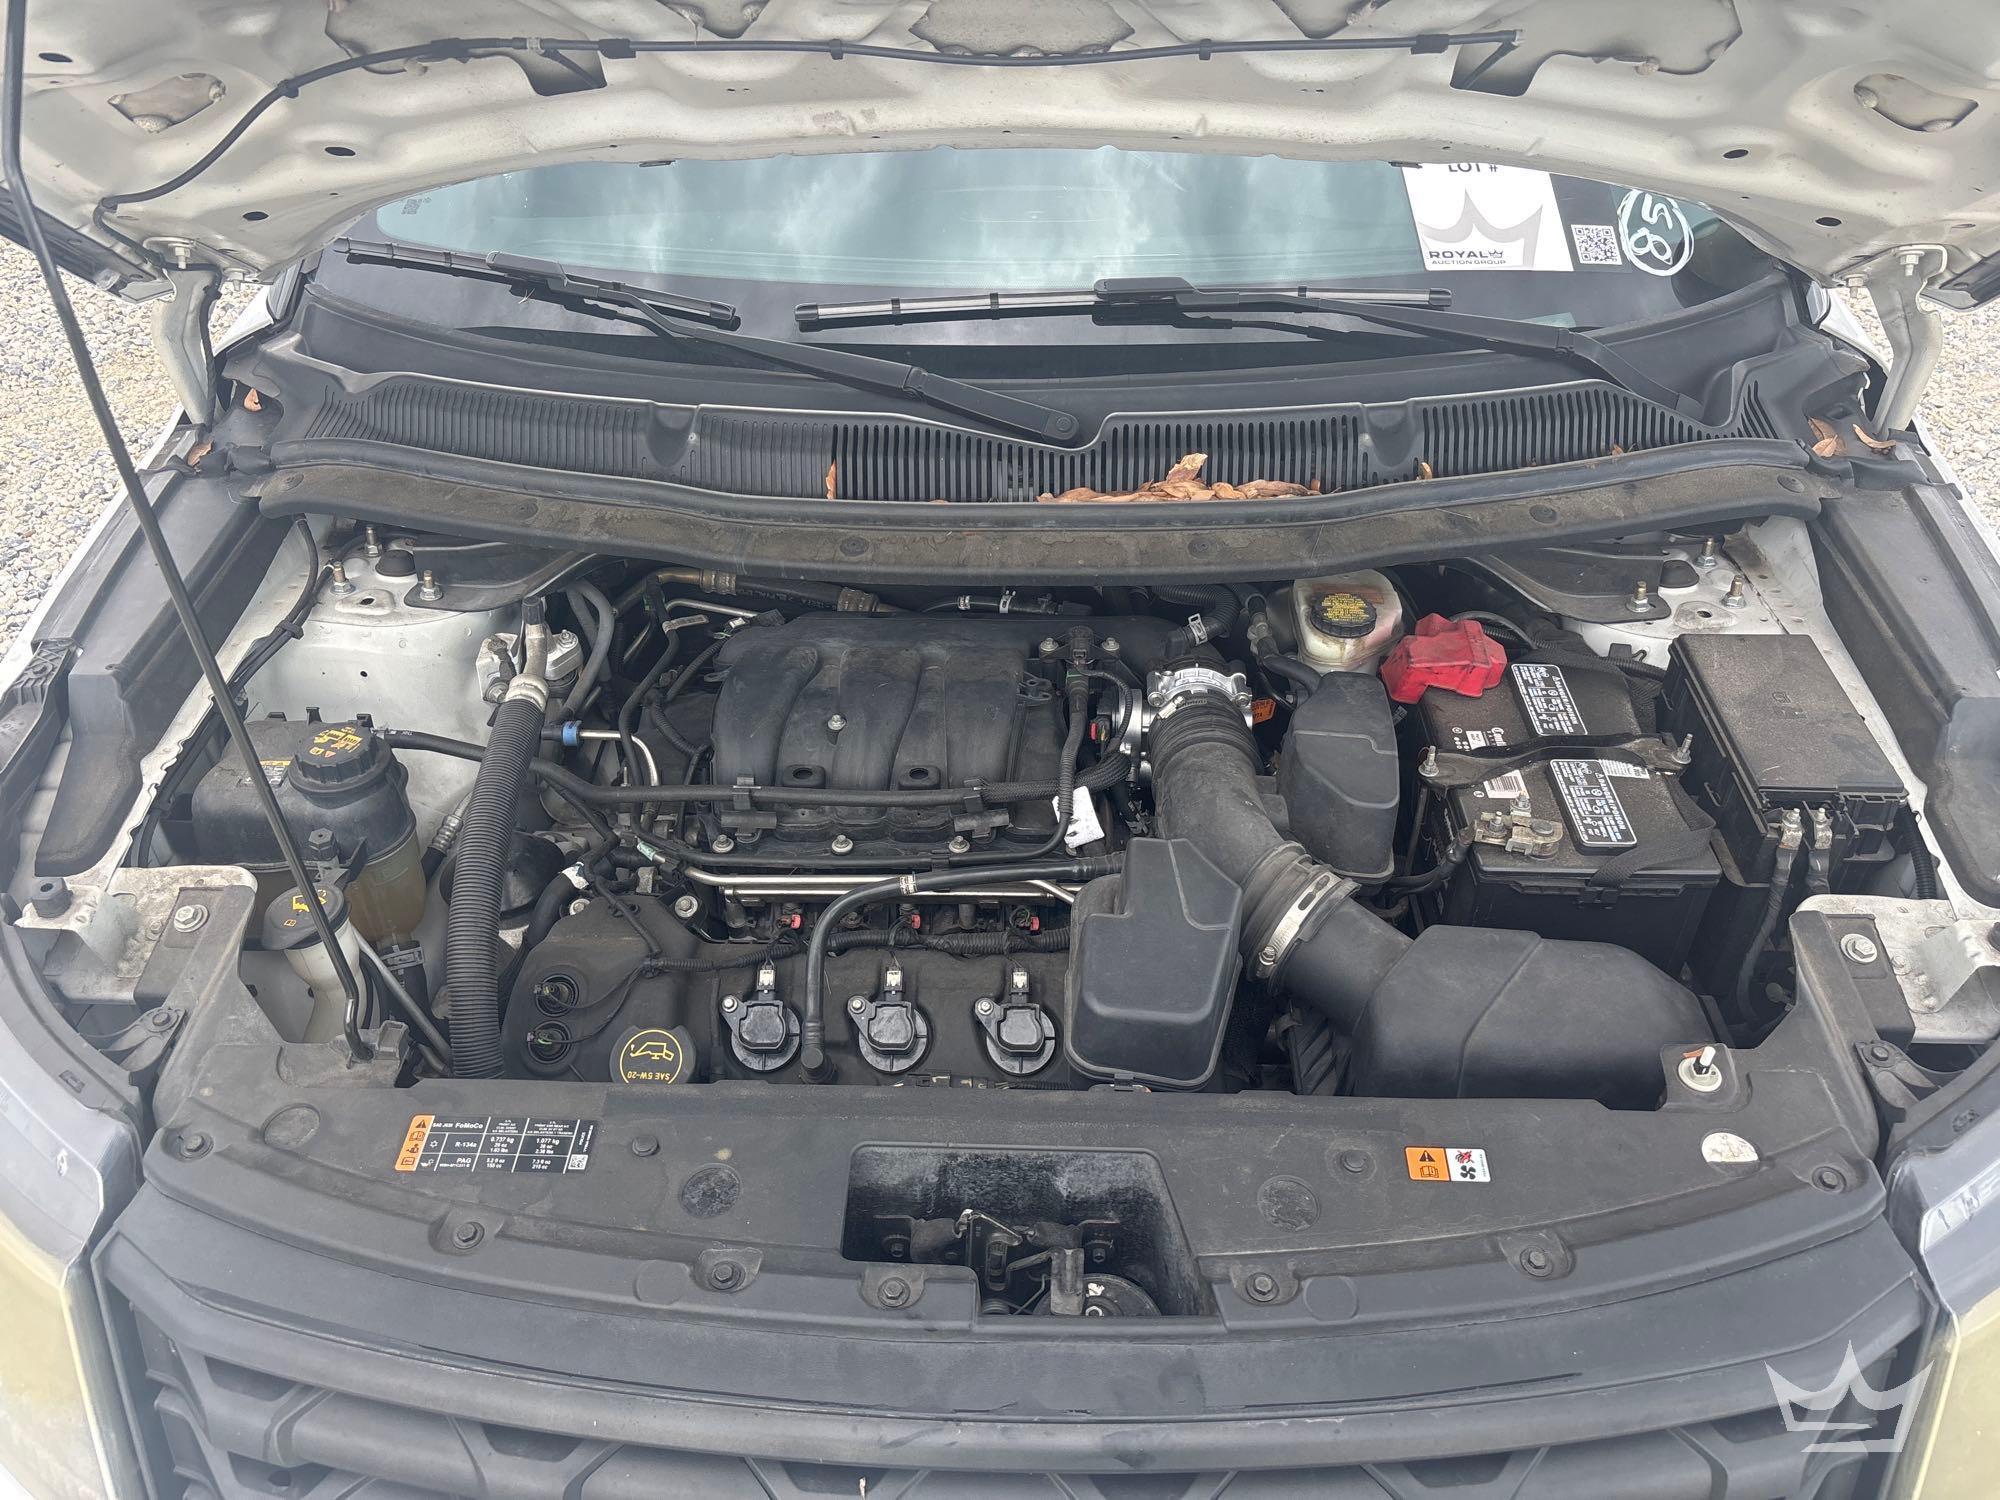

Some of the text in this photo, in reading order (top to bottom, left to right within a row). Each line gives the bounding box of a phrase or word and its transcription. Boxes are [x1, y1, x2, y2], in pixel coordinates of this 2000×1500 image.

[1448, 163, 1481, 173] LOT
[1429, 250, 1489, 259] ROYAL
[1598, 778, 1627, 830] DANGER/POISON
[627, 1071, 670, 1080] SAE 5W-20
